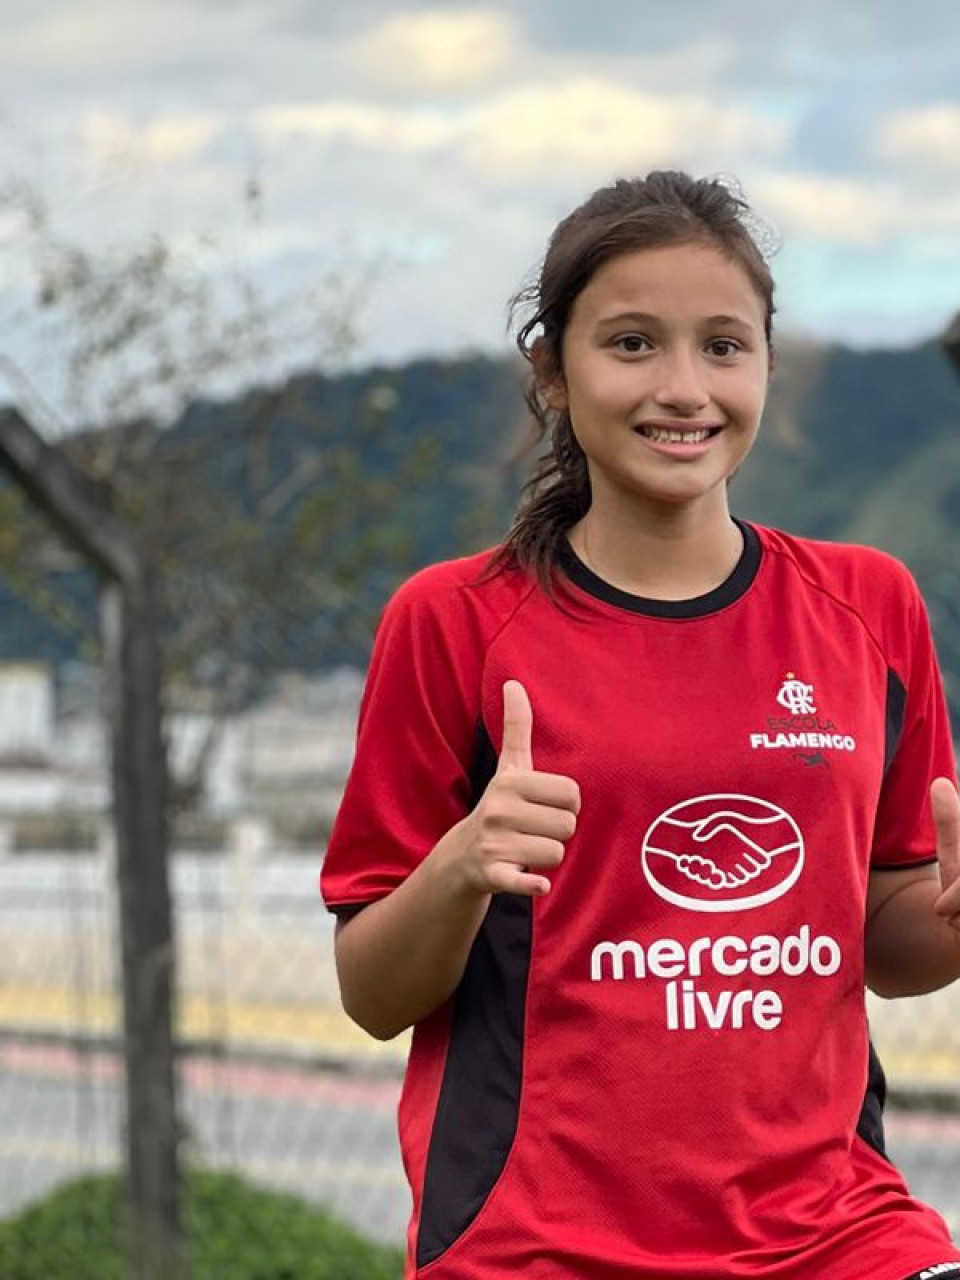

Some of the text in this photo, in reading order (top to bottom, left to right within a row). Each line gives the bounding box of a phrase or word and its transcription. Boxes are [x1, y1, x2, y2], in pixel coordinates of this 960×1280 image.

[749, 732, 857, 752] FLAMENGO
[590, 924, 842, 981] mercado
[665, 979, 783, 1030] livre
